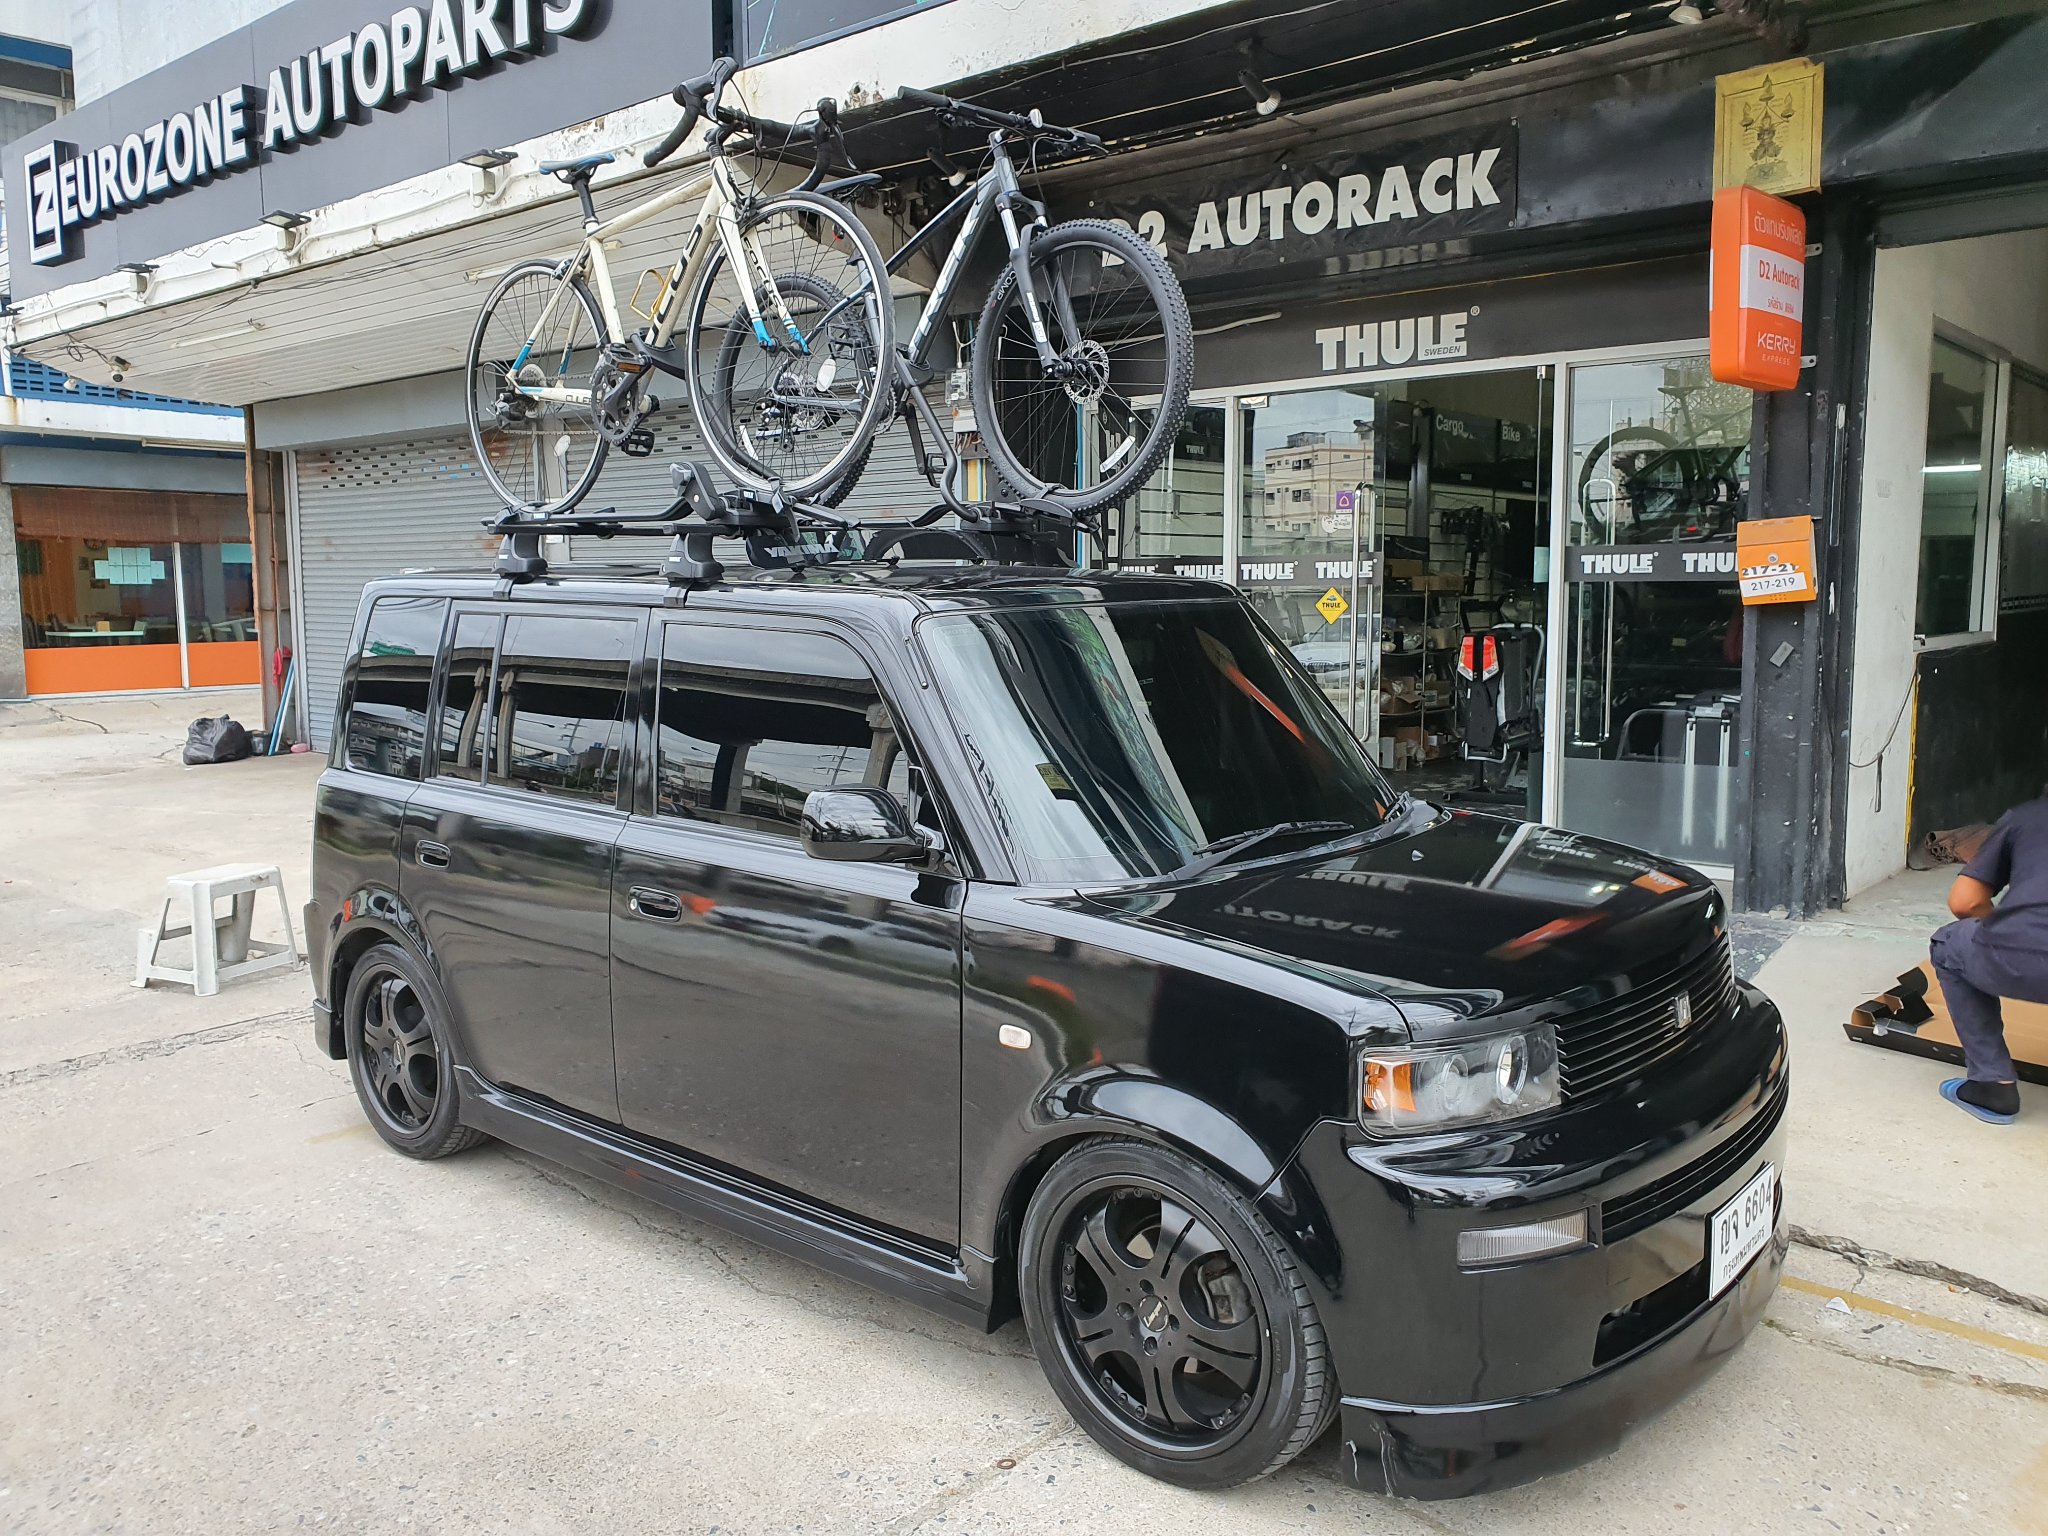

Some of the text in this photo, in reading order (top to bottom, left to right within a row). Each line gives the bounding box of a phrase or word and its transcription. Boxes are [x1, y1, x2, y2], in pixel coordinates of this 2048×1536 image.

[59, 86, 247, 226] EUROZONE
[1186, 147, 1501, 254] AUTORACK
[743, 236, 784, 308] FOCUS
[1759, 260, 1801, 292] D2 Autorack
[1315, 311, 1468, 371] THULE
[1423, 344, 1462, 357] SWEDEN
[1757, 331, 1796, 355] KERRY
[1761, 353, 1791, 366] EXPRESS
[1436, 413, 1464, 436] Cargo
[1502, 425, 1521, 442] Bike
[1240, 560, 1374, 581] THULE THULE
[1580, 552, 1654, 575] THULE
[1751, 576, 1796, 591] 217-219
[1744, 1174, 1772, 1228] 6604
